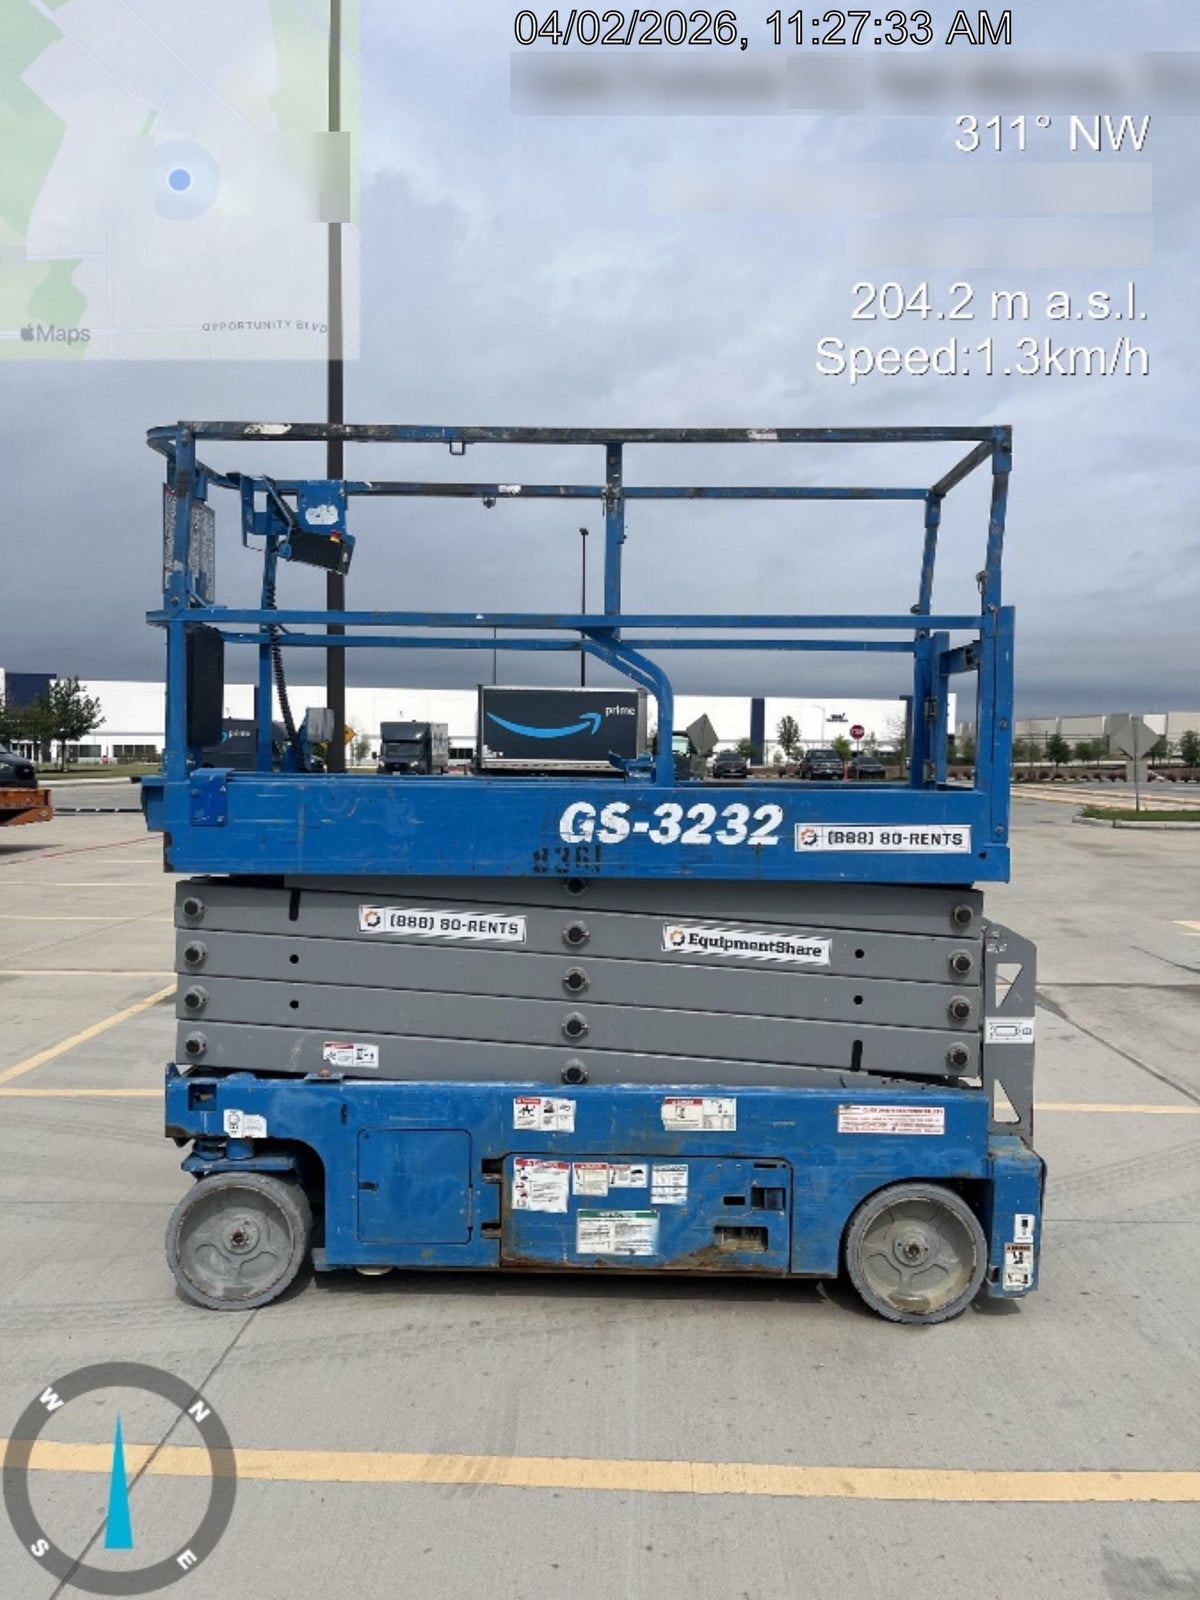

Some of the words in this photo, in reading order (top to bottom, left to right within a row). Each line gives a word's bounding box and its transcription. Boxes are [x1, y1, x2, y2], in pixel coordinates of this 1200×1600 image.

[605, 704, 636, 717] prime
[559, 801, 784, 846] GS-3232
[879, 831, 963, 846] 80-RENTS
[390, 913, 435, 931] (888)
[440, 918, 519, 936] 80-RENTS
[687, 932, 823, 957] EquipmentShare
